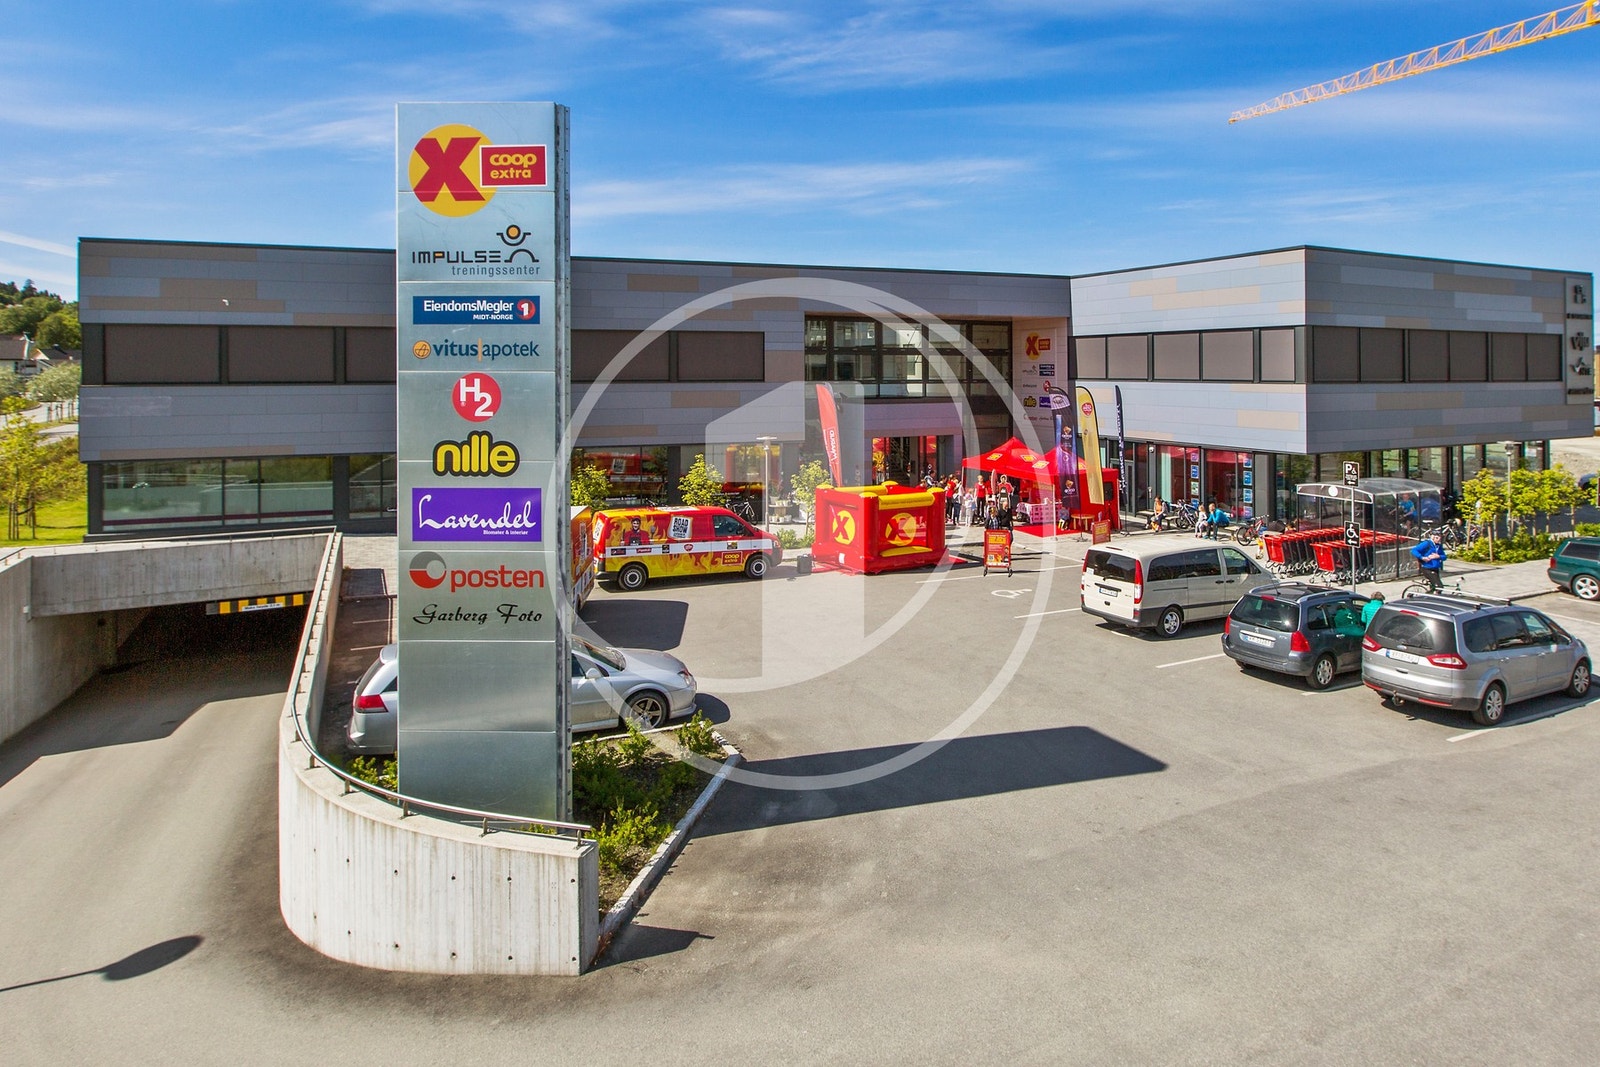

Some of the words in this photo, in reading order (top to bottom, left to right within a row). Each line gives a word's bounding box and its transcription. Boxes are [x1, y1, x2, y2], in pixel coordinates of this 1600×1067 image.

[489, 153, 537, 168] coop
[413, 137, 486, 202] X
[489, 167, 532, 179] extra
[412, 251, 501, 264] IMPULSE
[452, 264, 540, 277] treningssenter
[423, 300, 514, 314] EiendomsMegler
[520, 302, 530, 317] 1
[433, 431, 520, 477] nille
[418, 494, 537, 529] Lavendel
[672, 525, 688, 534] SHOW
[674, 518, 689, 527] ROAD
[450, 565, 544, 593] posten
[413, 603, 488, 625] Garberg
[496, 603, 543, 624] Foto
